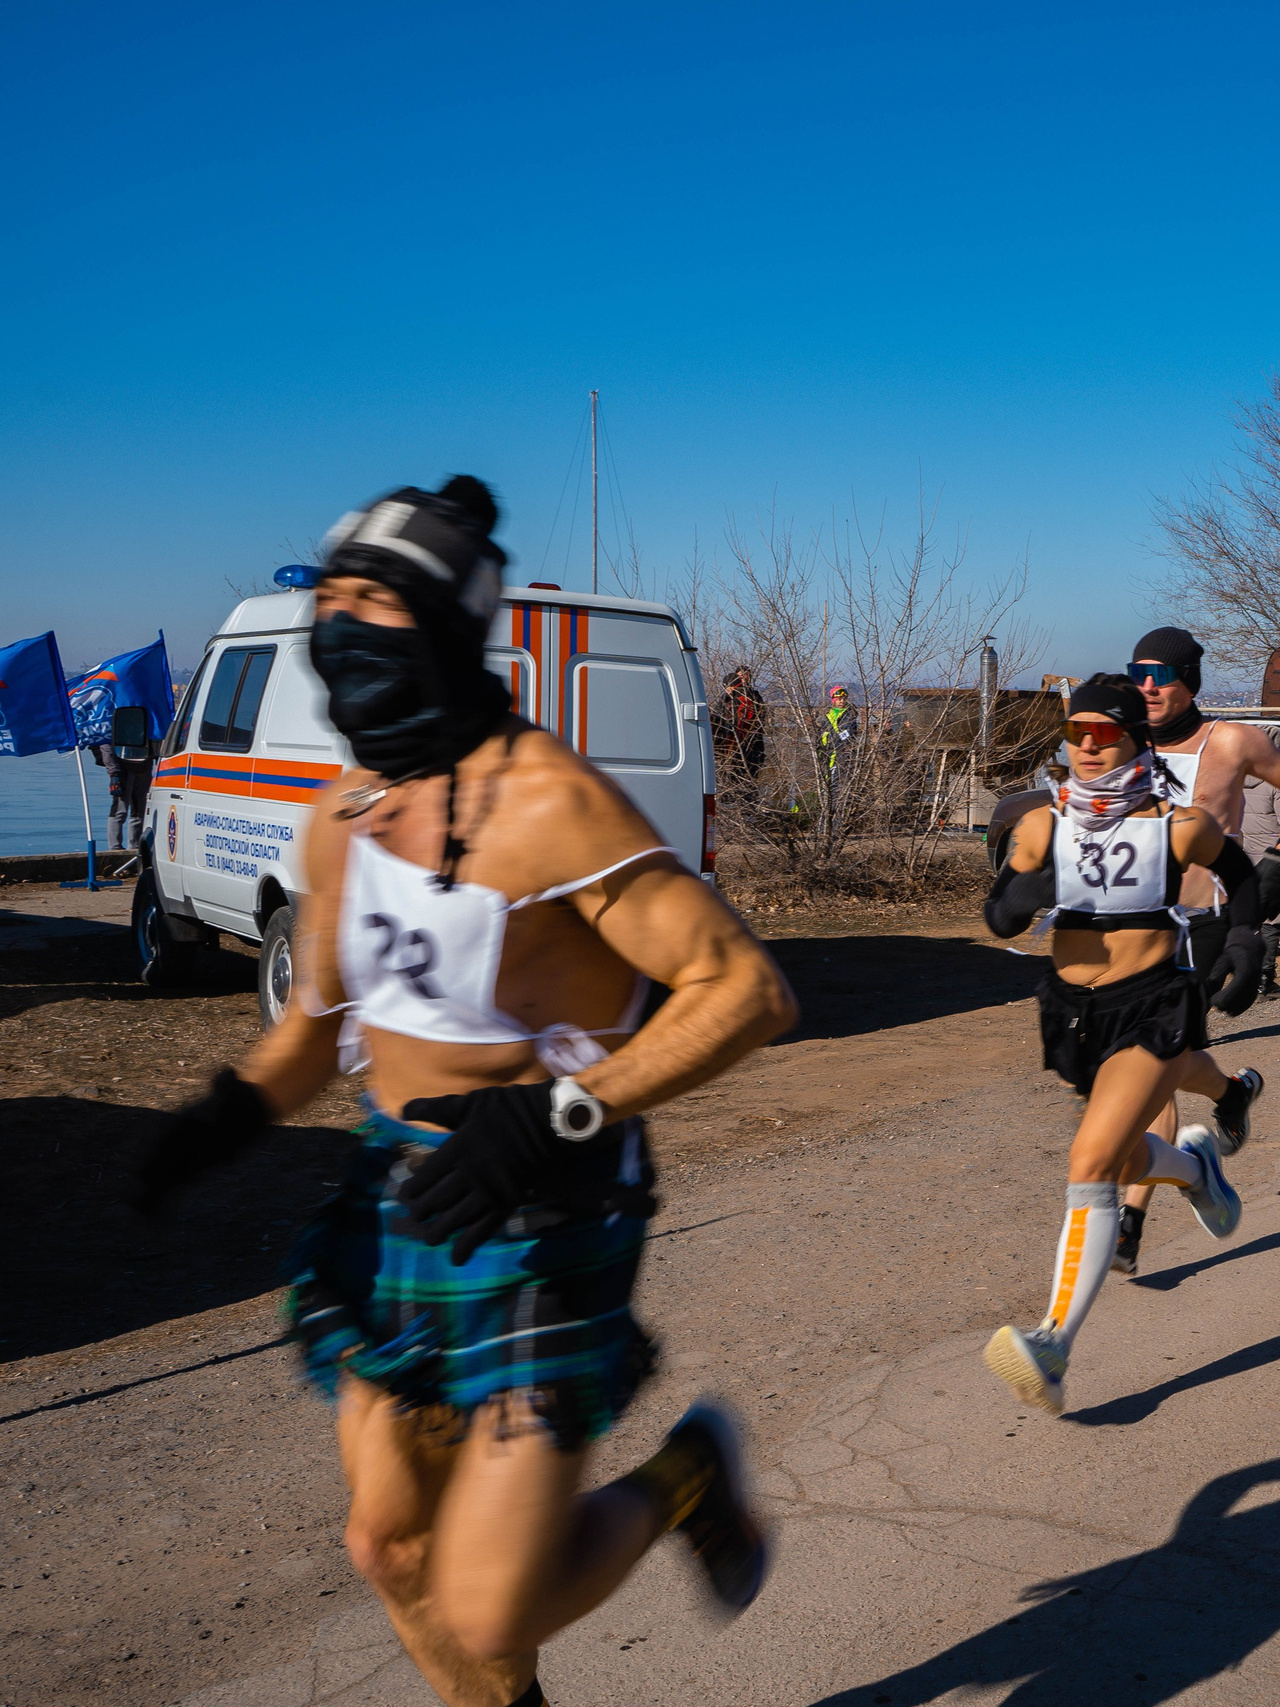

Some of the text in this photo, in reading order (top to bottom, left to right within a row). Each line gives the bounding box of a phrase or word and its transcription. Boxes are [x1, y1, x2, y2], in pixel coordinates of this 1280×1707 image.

[194, 811, 294, 842] АВАРИЙНО-СПАСАТЕЛЬНАЯ СЛУЖБА
[205, 833, 280, 861] ВОЛГОГРАДСКОЙ ОБЛАСТИ
[236, 860, 258, 878] 33-60-60
[1080, 841, 1140, 888] 32
